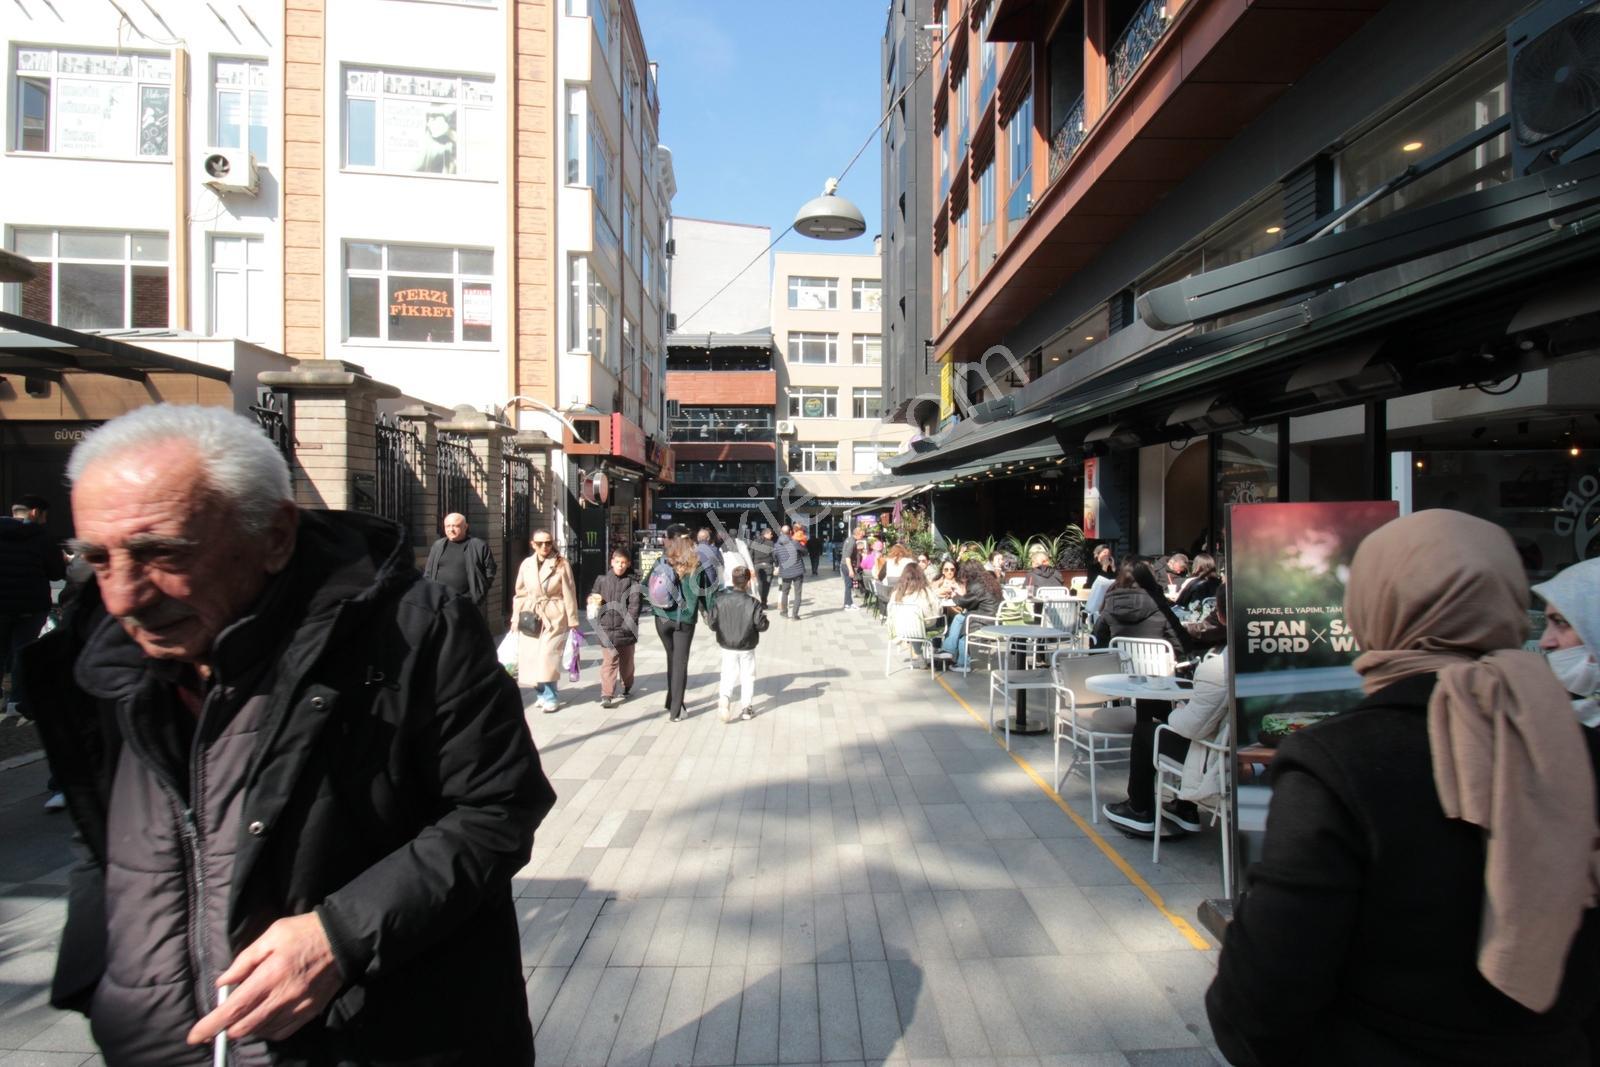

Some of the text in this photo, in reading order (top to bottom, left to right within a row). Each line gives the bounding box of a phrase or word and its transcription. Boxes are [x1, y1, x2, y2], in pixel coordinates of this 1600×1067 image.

[393, 288, 448, 305] TERZİ
[389, 303, 455, 318] FİKRET
[1246, 607, 1283, 616] TAPTAZE,
[1284, 607, 1294, 615] EL
[1247, 620, 1306, 637] STAN
[1248, 637, 1310, 654] FORD
